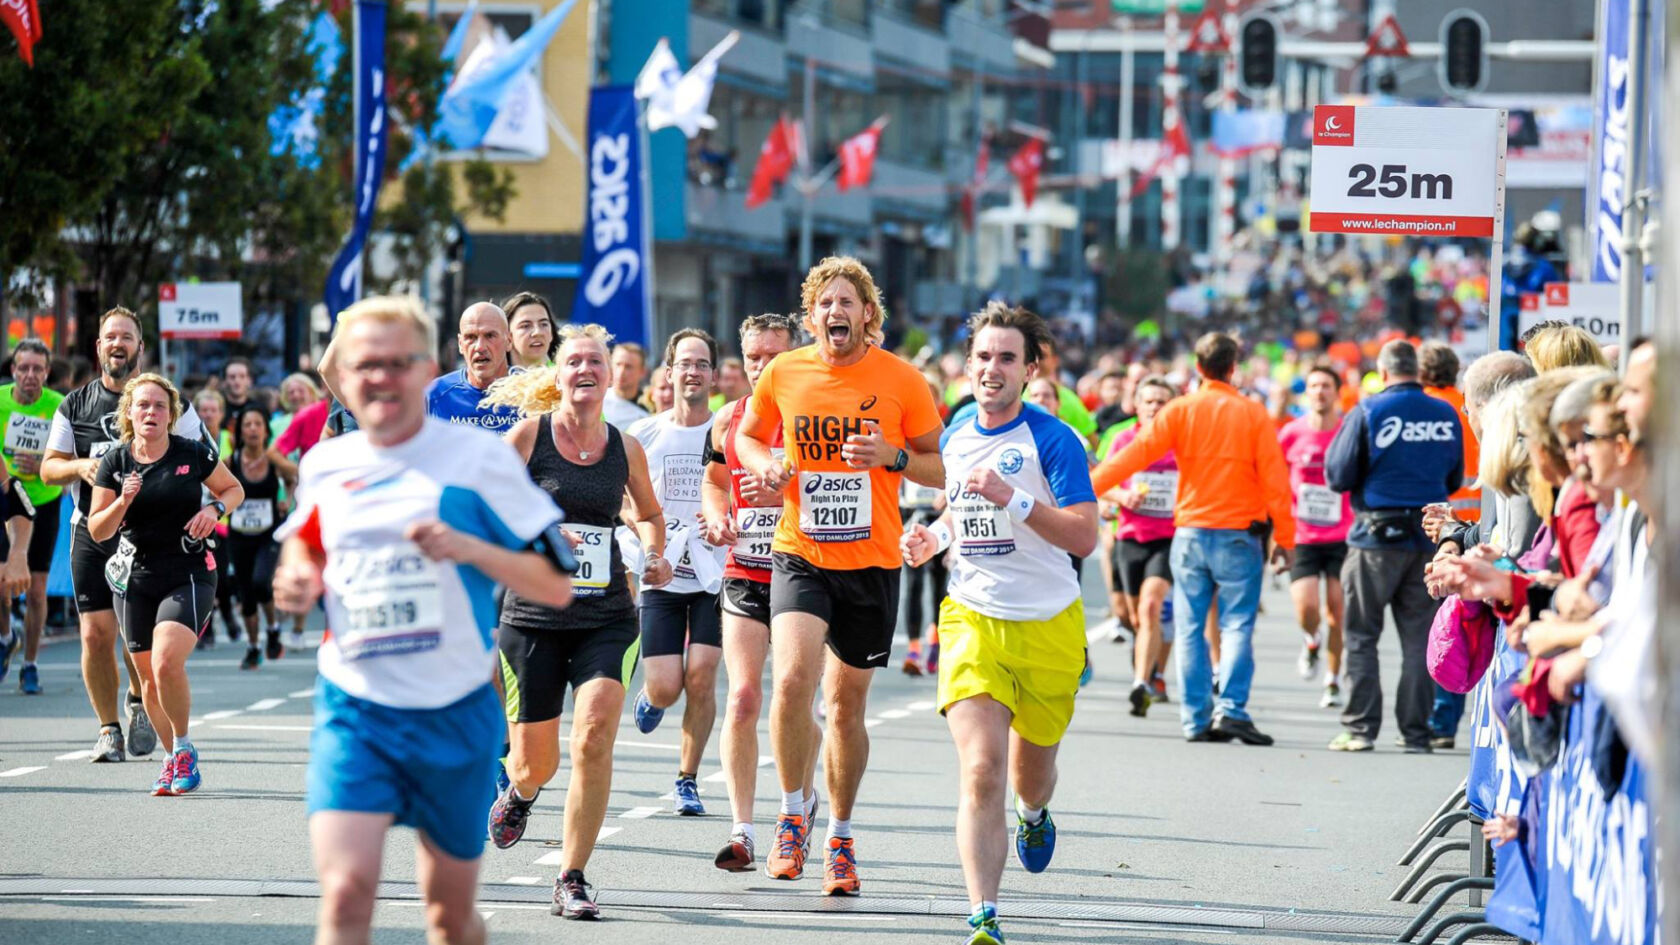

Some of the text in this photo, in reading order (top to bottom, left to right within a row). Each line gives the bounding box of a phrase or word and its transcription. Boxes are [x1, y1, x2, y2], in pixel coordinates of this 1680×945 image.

[1347, 163, 1453, 200] 25m
[1342, 219, 1455, 231] www.lechampion.nl
[176, 308, 219, 323] 75m
[797, 443, 822, 461] TO
[174, 465, 190, 475] NB
[811, 494, 858, 503] Right To Play
[811, 507, 857, 526] 12107
